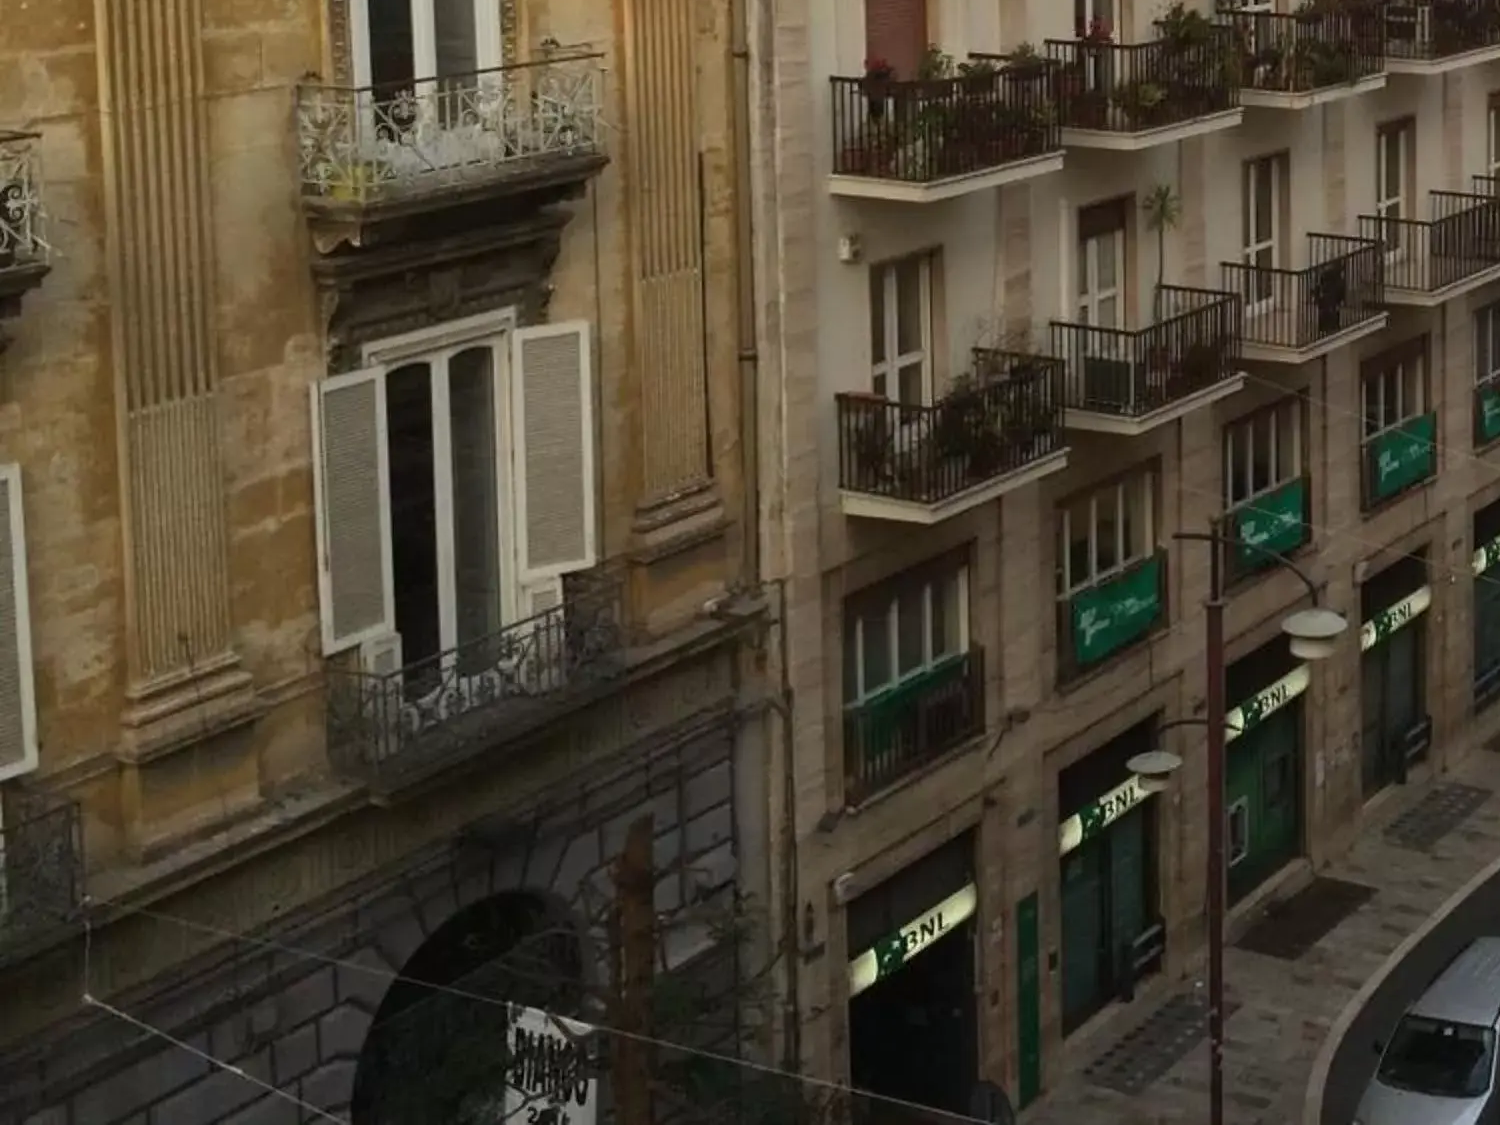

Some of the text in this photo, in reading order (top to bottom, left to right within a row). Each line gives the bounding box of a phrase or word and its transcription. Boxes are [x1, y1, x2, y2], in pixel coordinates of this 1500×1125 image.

[1261, 684, 1291, 712] BNL
[1103, 786, 1139, 820] BNL
[903, 913, 949, 953] BNL
